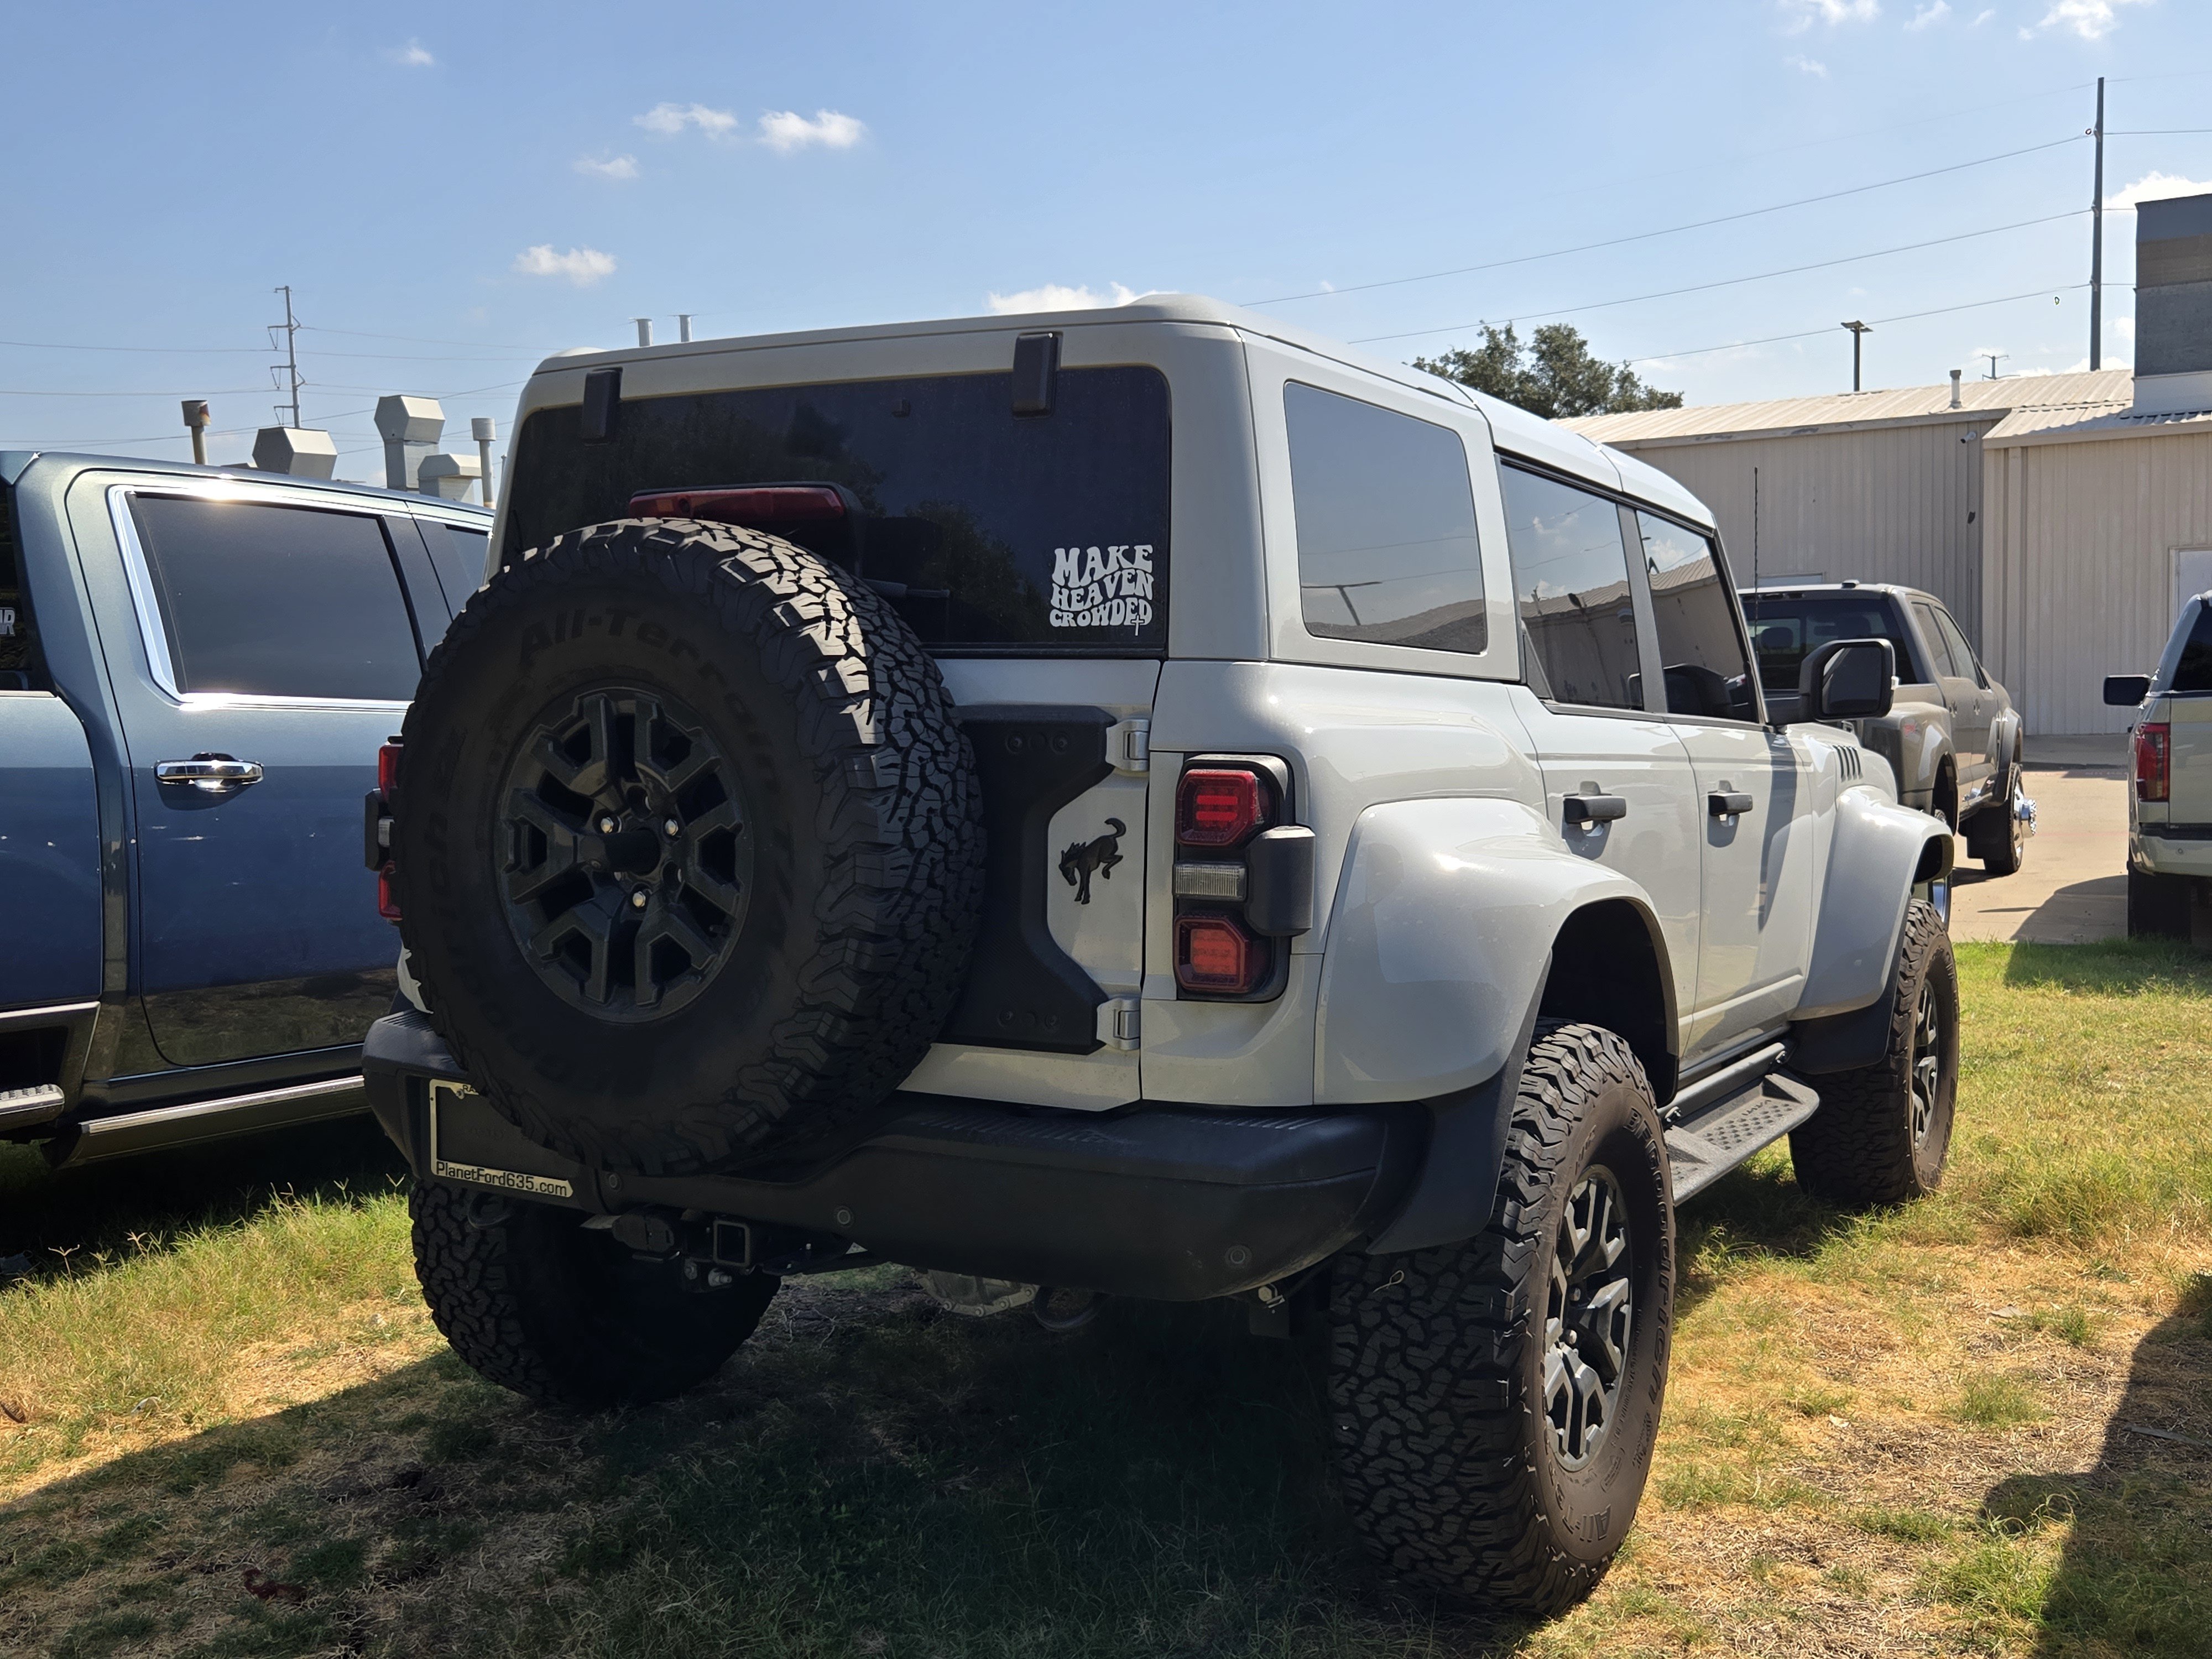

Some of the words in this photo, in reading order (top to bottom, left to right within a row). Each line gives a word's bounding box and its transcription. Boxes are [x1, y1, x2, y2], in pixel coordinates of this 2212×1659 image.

[1052, 545, 1153, 588] MAKE
[1051, 569, 1154, 611] HEAVEN
[1050, 597, 1152, 627] CROWDED
[436, 1161, 568, 1197] PlanetFord635.com
